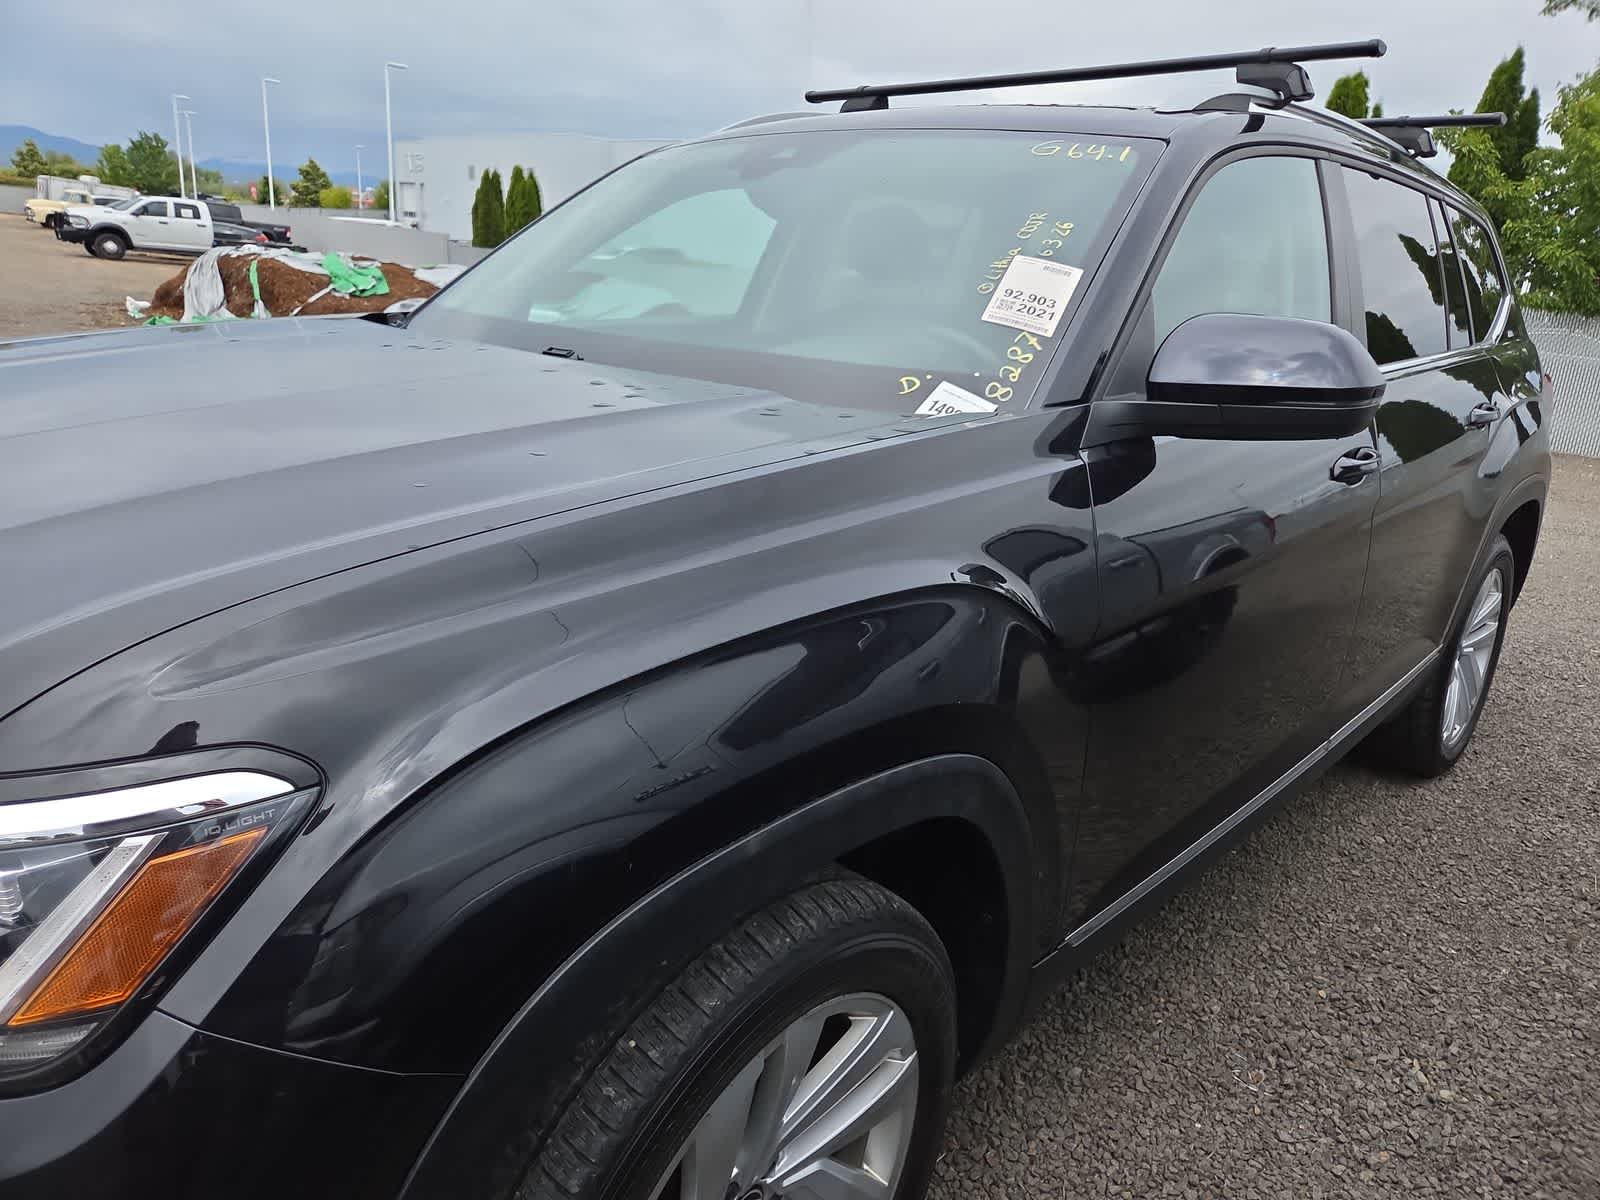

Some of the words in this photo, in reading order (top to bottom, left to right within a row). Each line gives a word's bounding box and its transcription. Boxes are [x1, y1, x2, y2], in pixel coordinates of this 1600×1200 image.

[1016, 303, 1056, 321] 2021
[985, 331, 1043, 401] 8287
[204, 808, 276, 837] IQ.LIGHT
